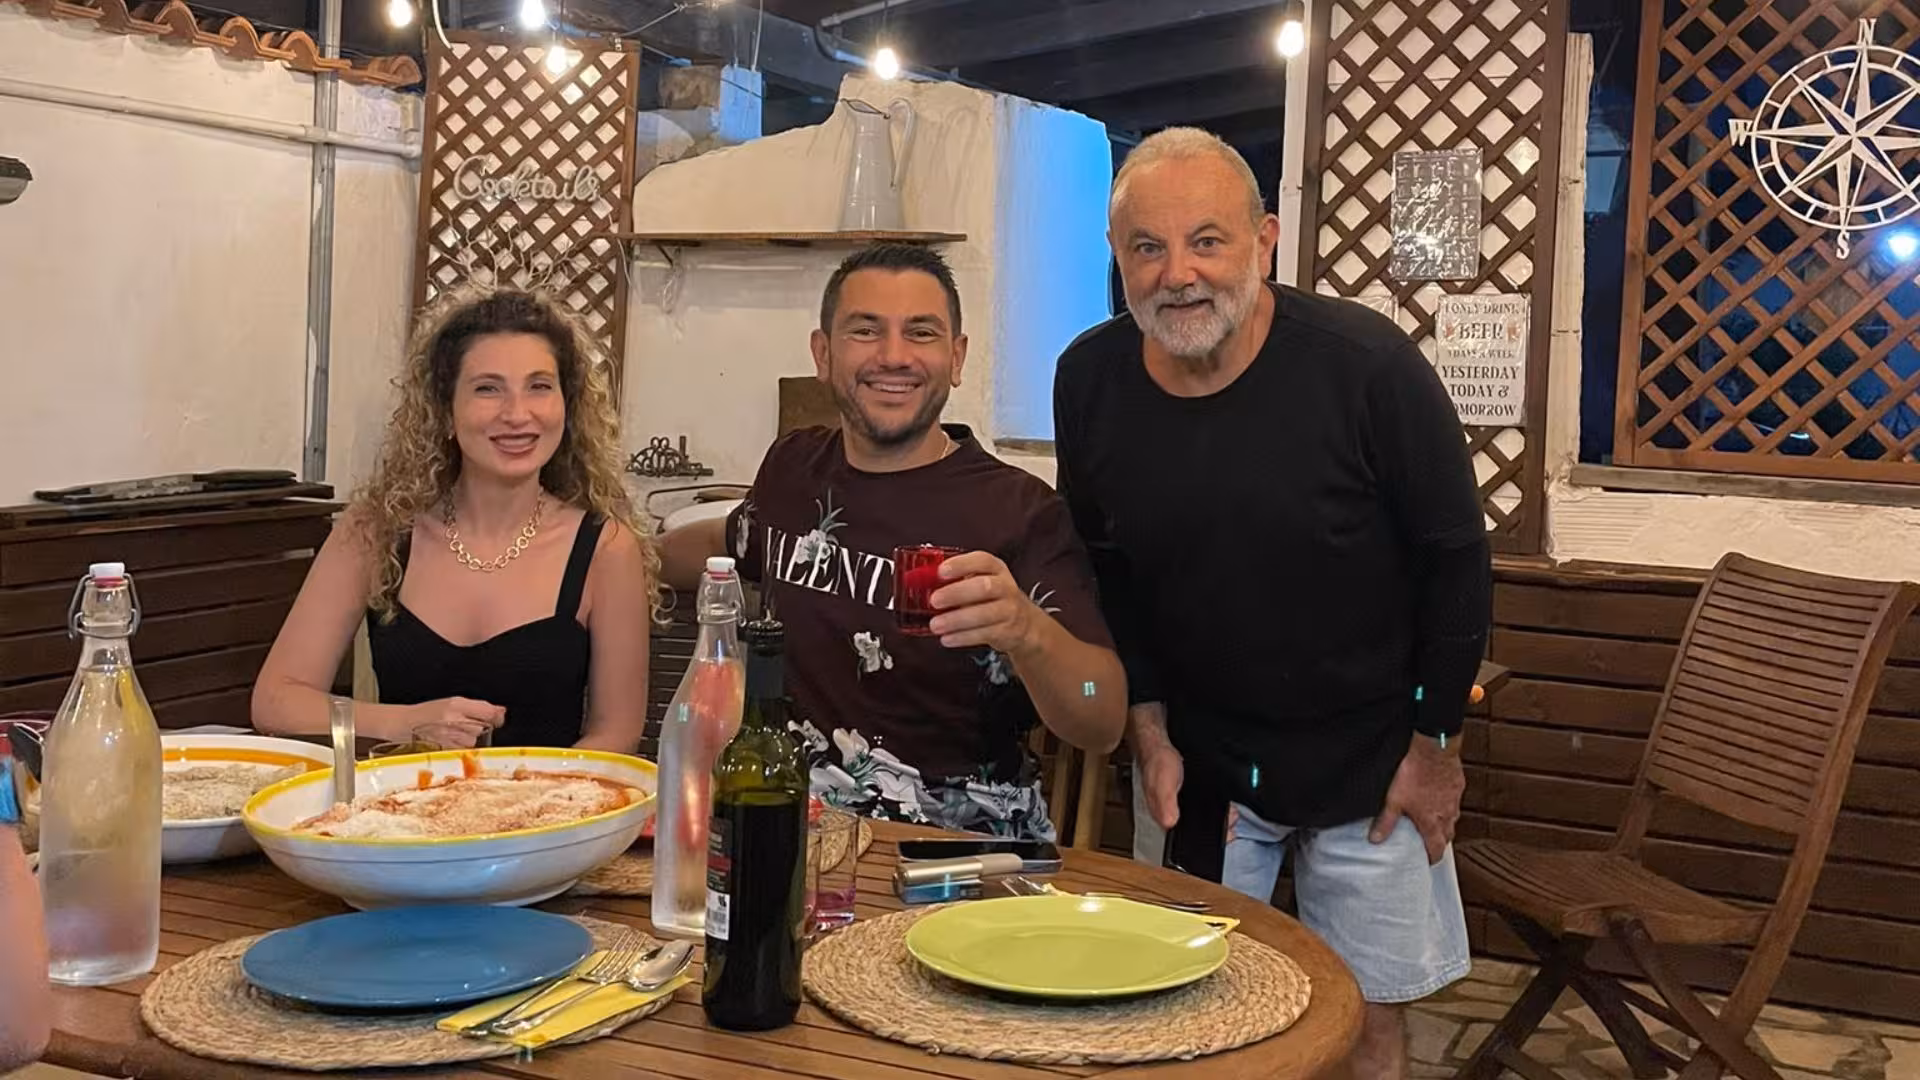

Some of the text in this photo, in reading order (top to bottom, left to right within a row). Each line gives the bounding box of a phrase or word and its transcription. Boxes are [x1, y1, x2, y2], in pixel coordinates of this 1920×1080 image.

[1857, 18, 1876, 47] N
[1728, 119, 1753, 147] W
[453, 154, 600, 202] Cocktails
[1835, 230, 1850, 259] S
[1451, 303, 1480, 314] ONLY
[1483, 303, 1520, 314] DRINK
[1459, 323, 1503, 340] BEER
[1442, 366, 1519, 379] YESTERDAY
[1449, 384, 1509, 398] TODAY &
[1454, 403, 1516, 416] MORROW
[765, 526, 895, 611] VALENT
